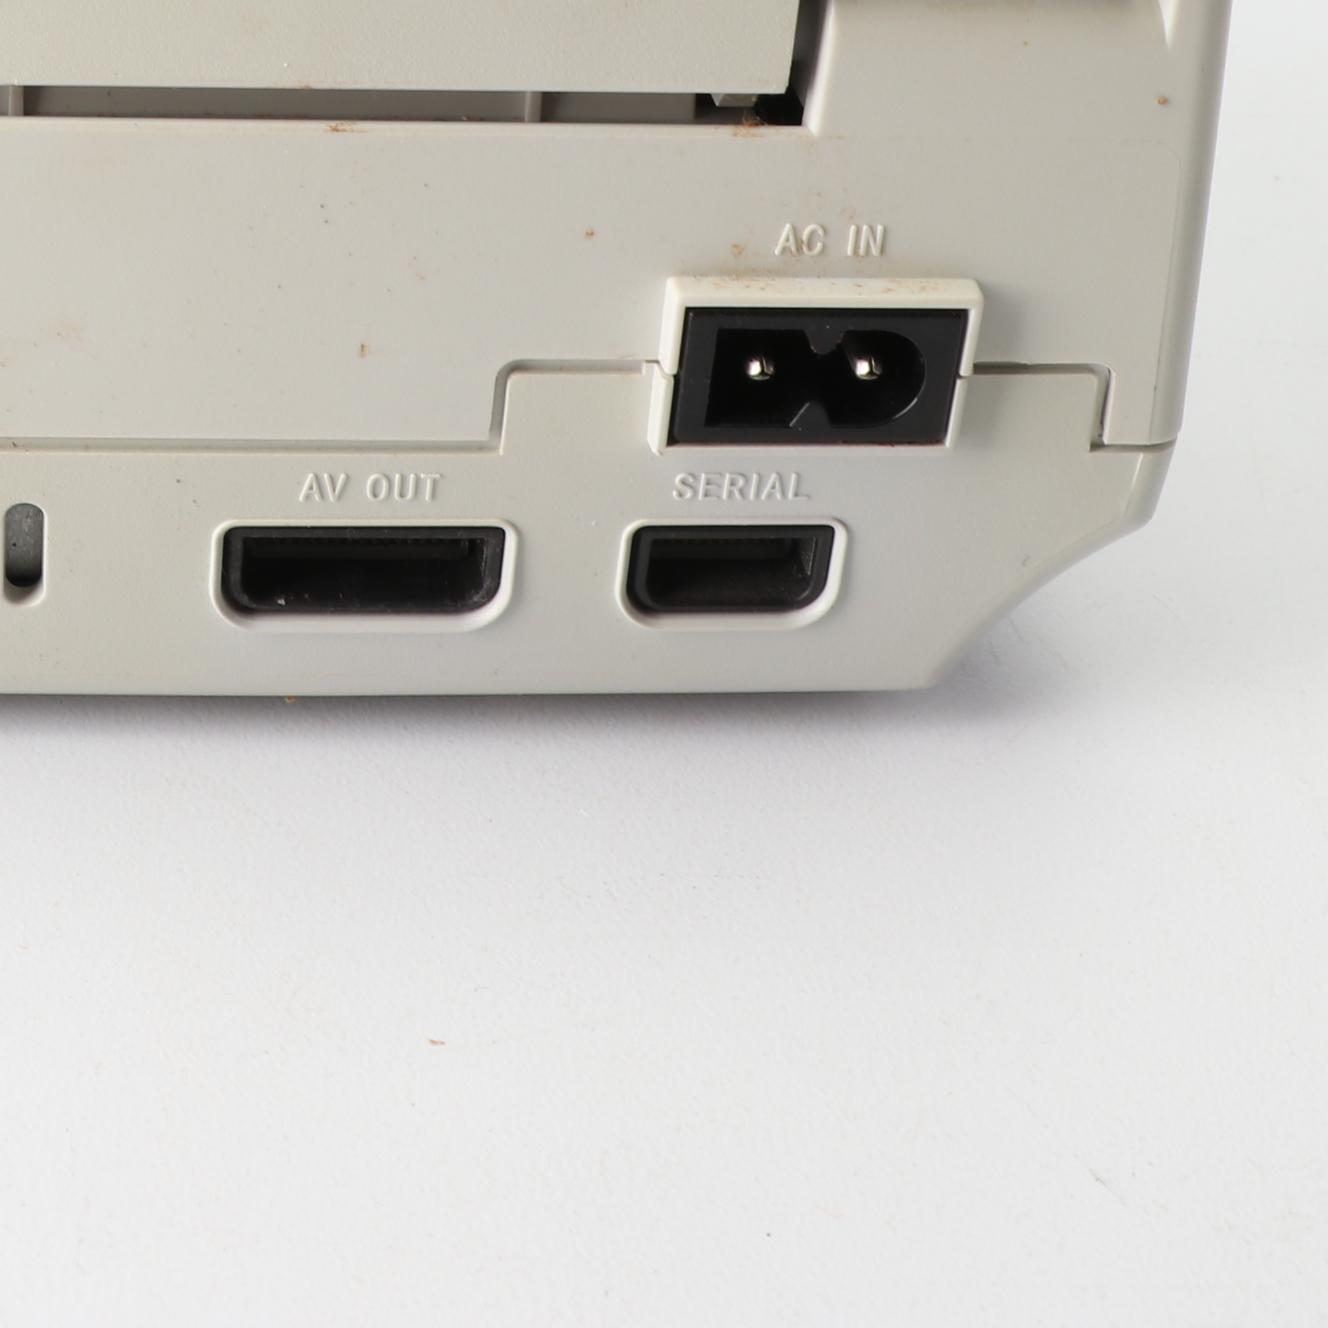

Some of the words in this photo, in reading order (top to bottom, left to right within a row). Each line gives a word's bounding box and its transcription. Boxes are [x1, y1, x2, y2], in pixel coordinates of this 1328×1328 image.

[774, 223, 826, 258] AC
[846, 223, 886, 257] IN
[298, 472, 347, 504] AV
[365, 472, 441, 504] OUT
[672, 471, 812, 503] SERIAL
